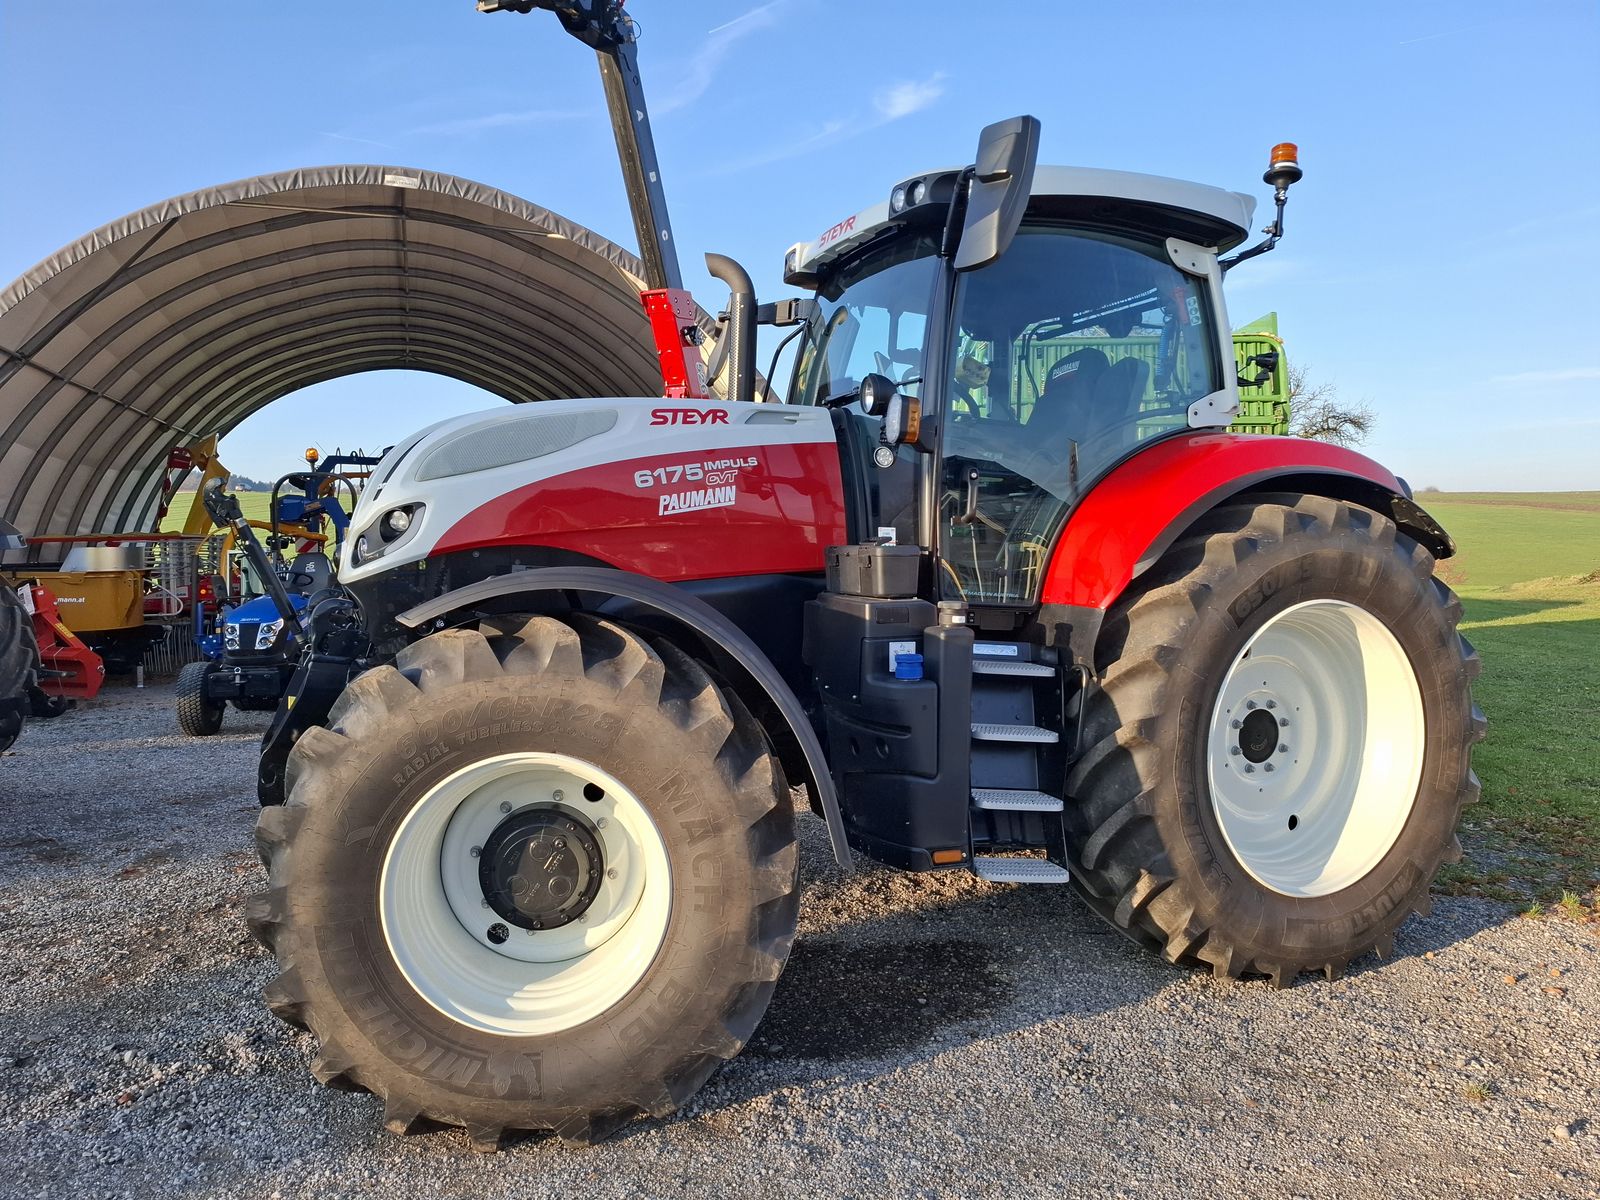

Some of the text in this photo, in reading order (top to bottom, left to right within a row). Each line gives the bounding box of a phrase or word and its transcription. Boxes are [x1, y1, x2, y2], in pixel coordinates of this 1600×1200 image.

[818, 215, 856, 248] STEYR
[1052, 360, 1080, 379] PAUMANN
[650, 408, 730, 425] STEYR
[634, 457, 758, 488] 6175 IMPULS
[706, 470, 738, 486] CVT
[659, 485, 736, 516] PAUMANN
[392, 741, 450, 787] RADIAL
[456, 720, 544, 745] TUBELESS
